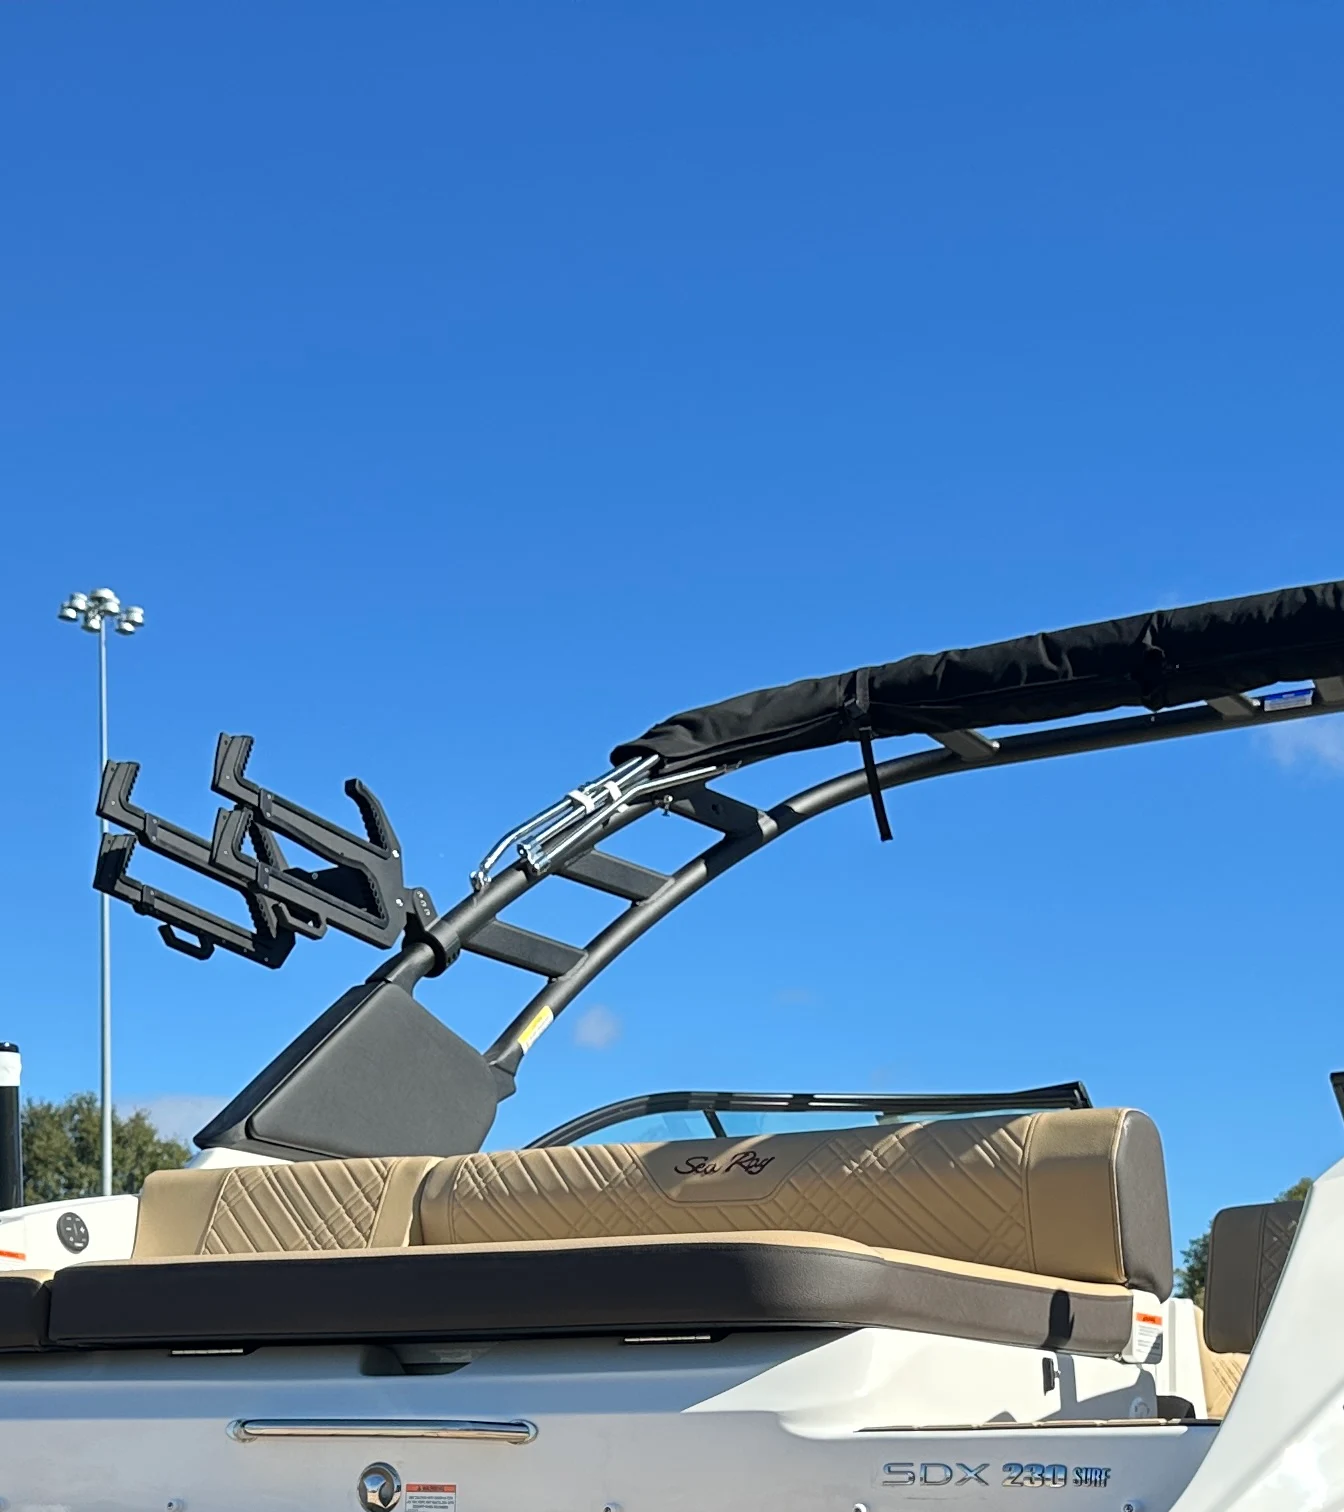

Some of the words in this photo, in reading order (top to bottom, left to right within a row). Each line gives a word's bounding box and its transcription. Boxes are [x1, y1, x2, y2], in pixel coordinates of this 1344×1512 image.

[674, 1156, 722, 1176] Sea
[725, 1151, 775, 1175] Ray
[882, 1462, 990, 1487] SDX
[1002, 1463, 1068, 1489] 230
[1072, 1467, 1112, 1488] SURF
